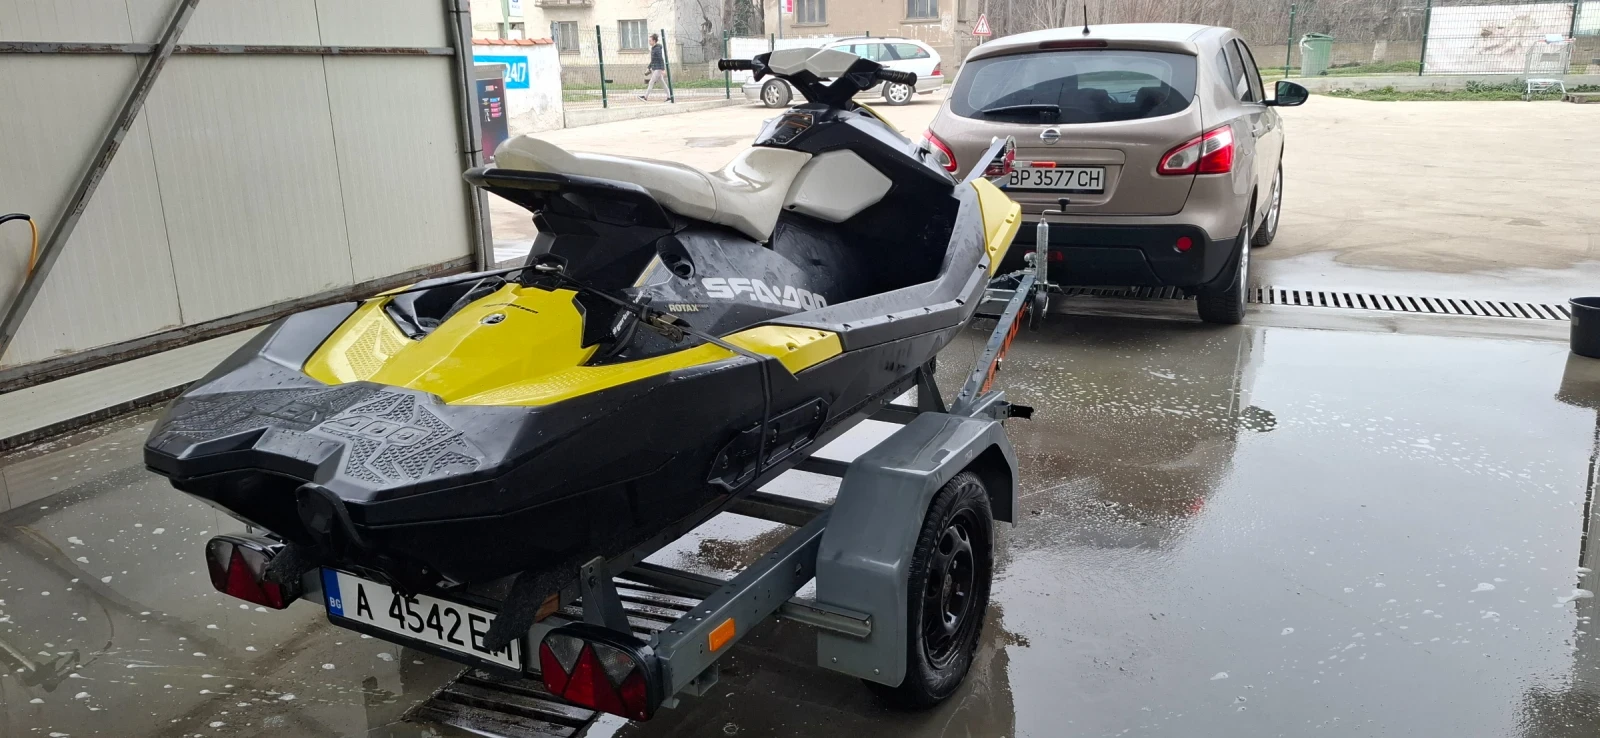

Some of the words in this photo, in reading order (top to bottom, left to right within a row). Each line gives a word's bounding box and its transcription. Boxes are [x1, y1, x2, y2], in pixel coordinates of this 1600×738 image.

[1009, 170, 1031, 187] BP
[1033, 170, 1075, 187] 3577
[1077, 170, 1100, 187] CH
[668, 303, 699, 312] ROTAX
[329, 596, 341, 609] BG
[357, 583, 374, 620] A
